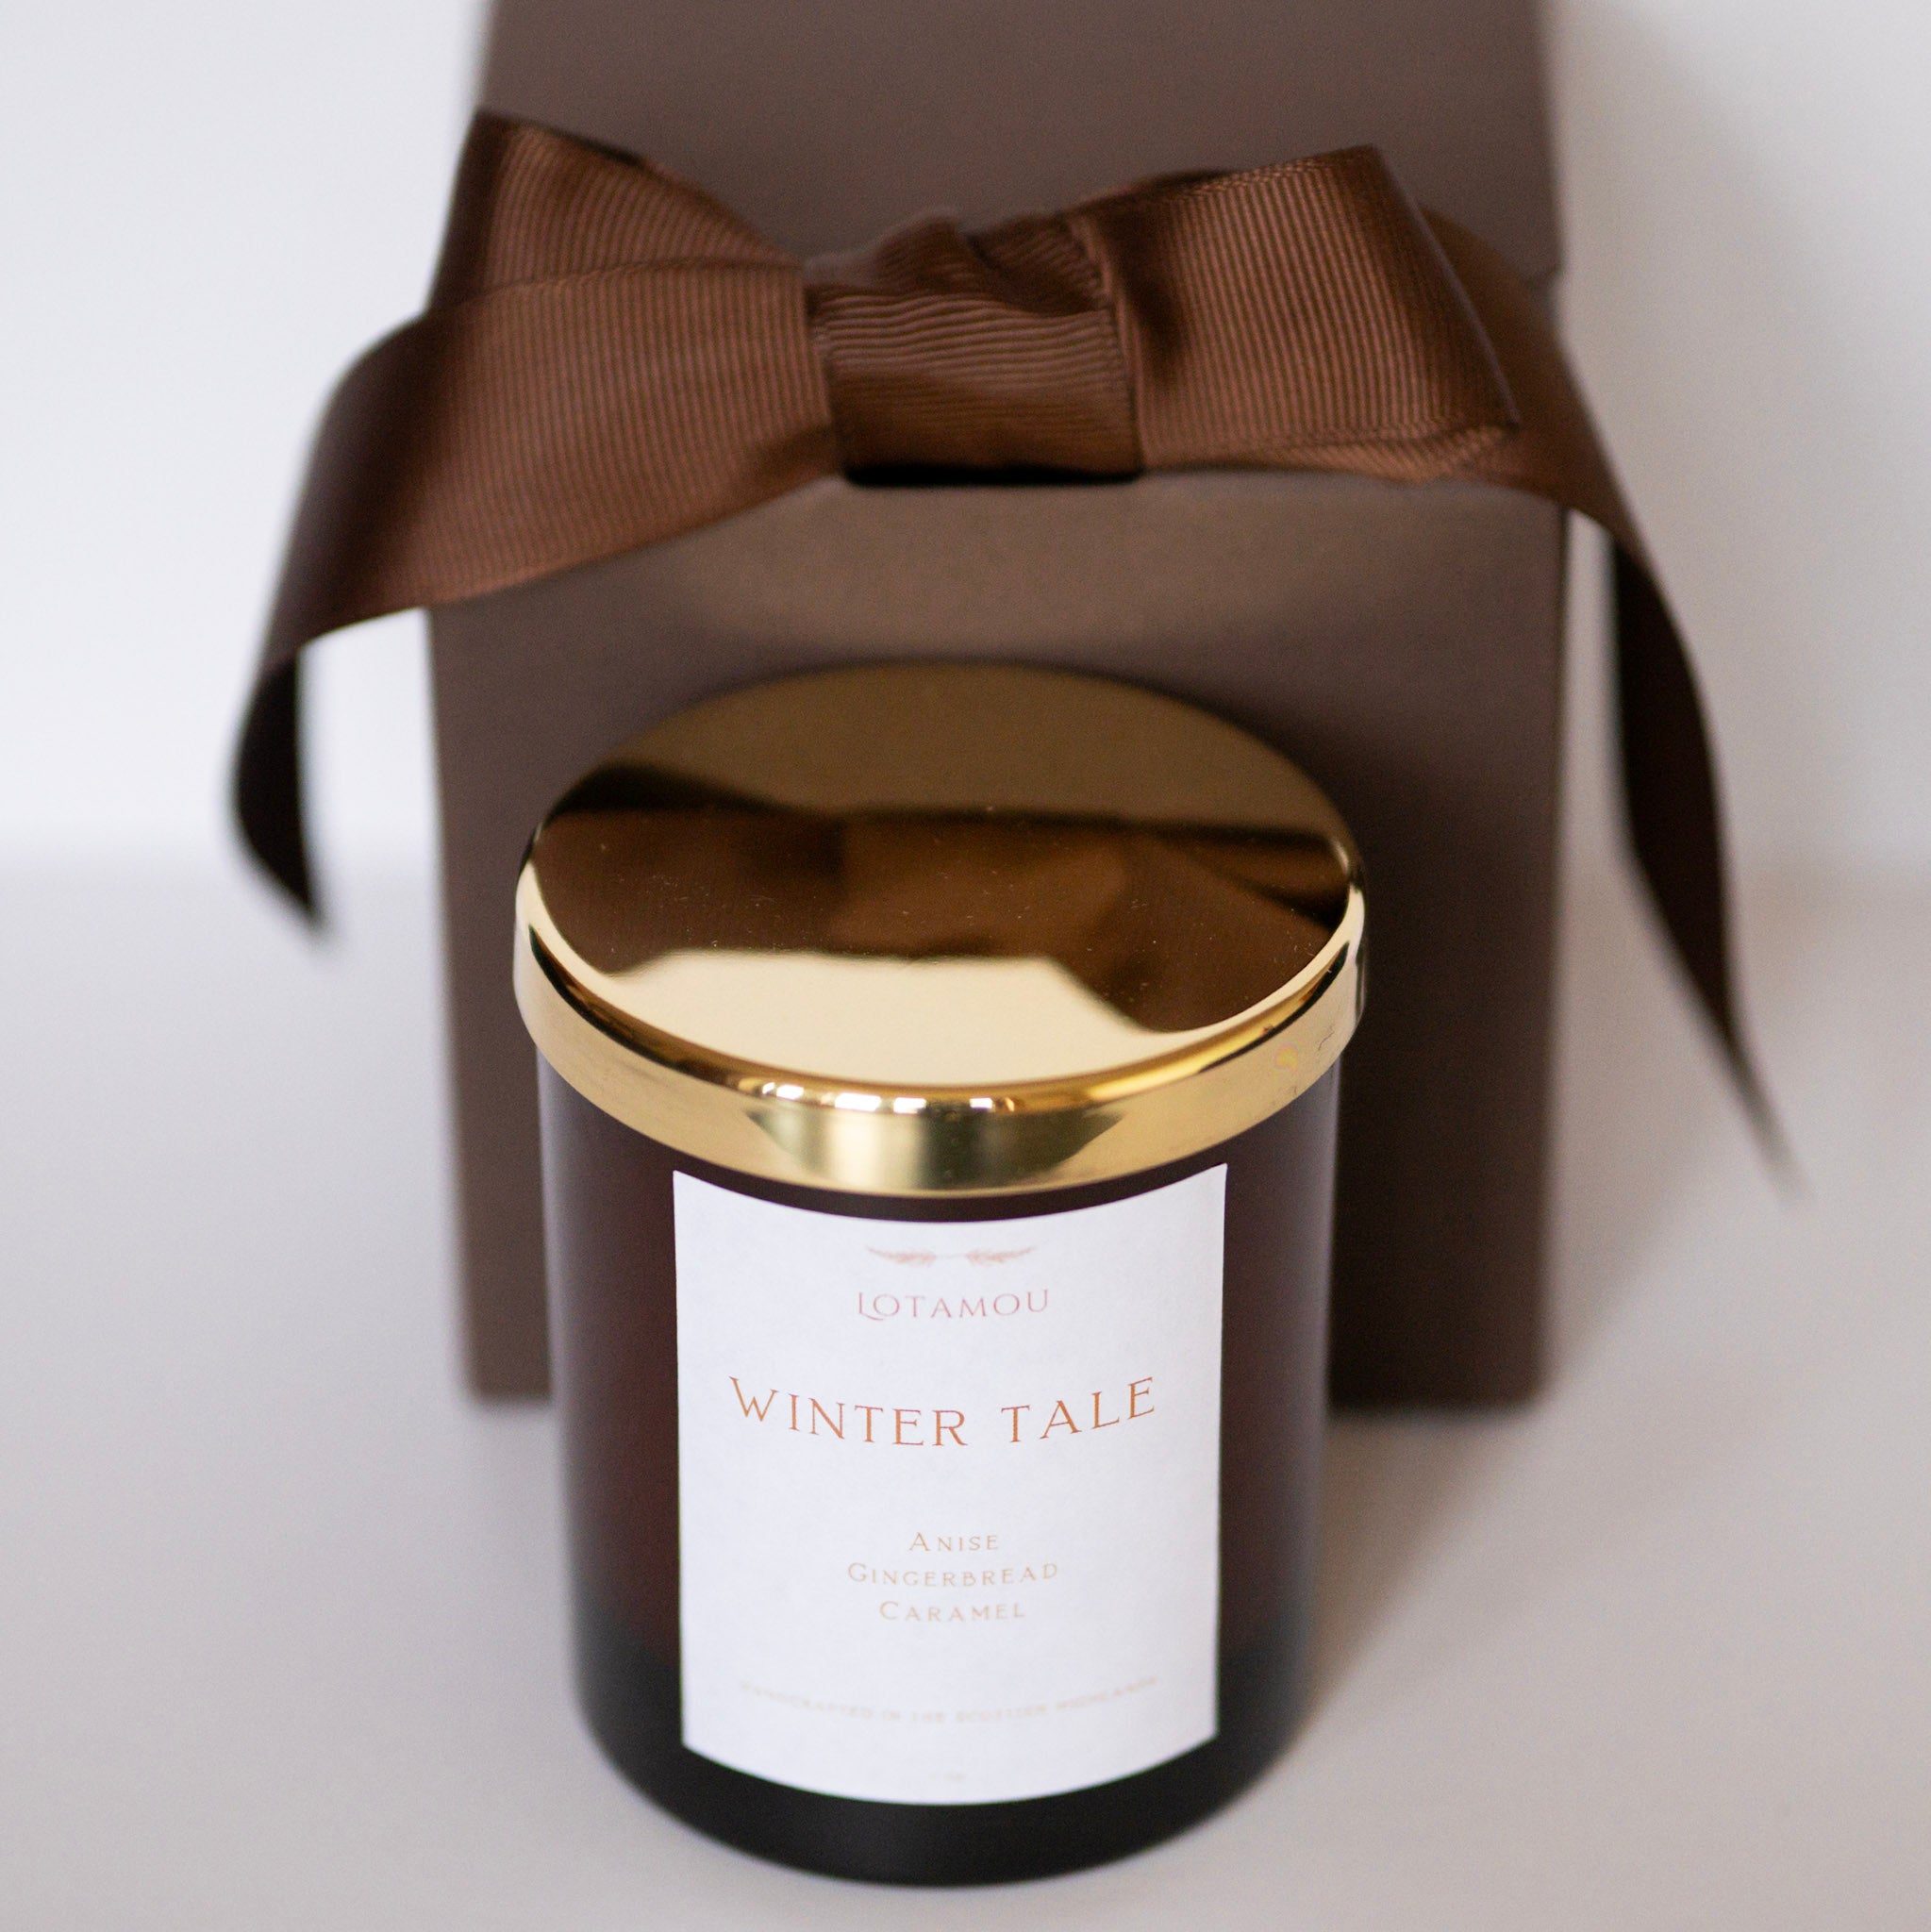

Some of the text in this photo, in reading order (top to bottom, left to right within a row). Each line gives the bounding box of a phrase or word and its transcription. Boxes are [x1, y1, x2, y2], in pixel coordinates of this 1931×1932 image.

[857, 1289, 1048, 1322] LOTAMOU
[729, 1376, 1156, 1446] WINTER TALE
[908, 1531, 998, 1552] ANISE
[847, 1562, 1058, 1588] GINGERBREAD
[878, 1601, 1025, 1623] CARAMEL
